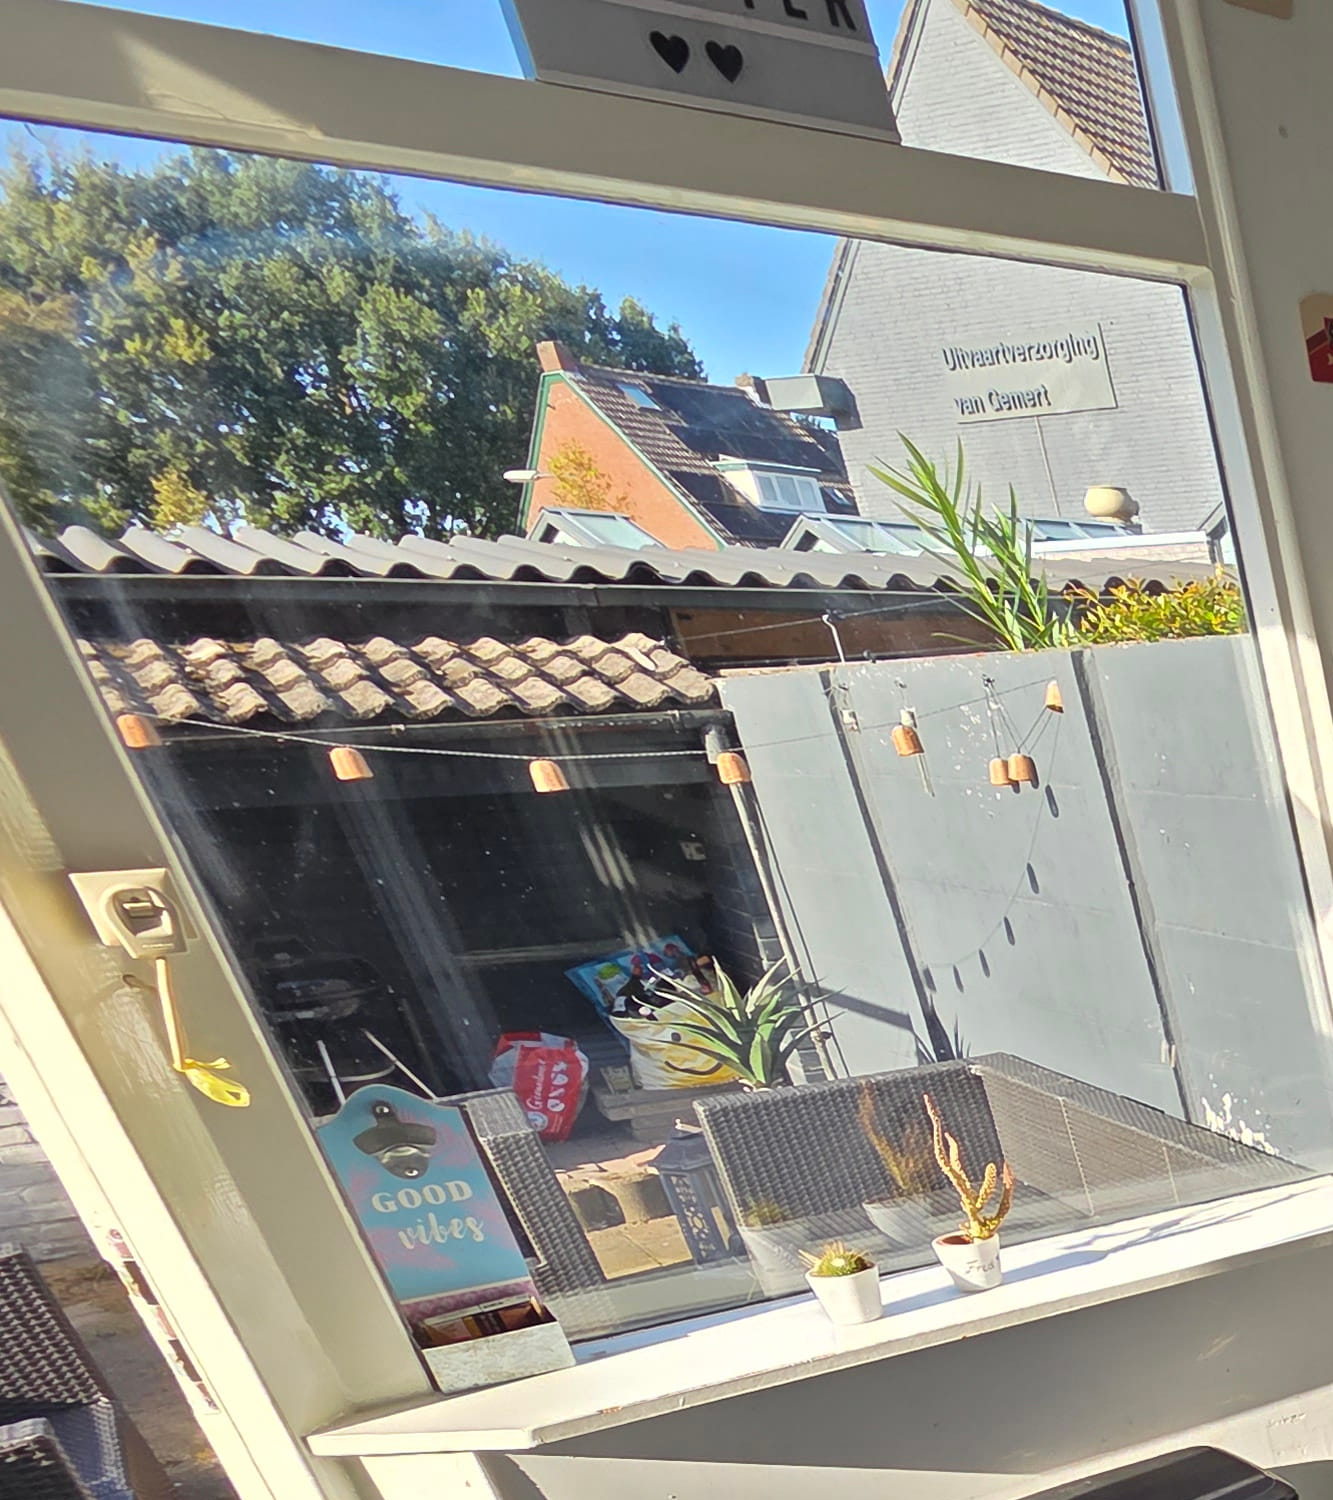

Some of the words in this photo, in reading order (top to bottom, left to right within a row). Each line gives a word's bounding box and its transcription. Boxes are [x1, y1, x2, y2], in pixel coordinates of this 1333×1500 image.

[943, 333, 1100, 371] Uitvaartverzorging
[955, 395, 986, 415] van
[988, 384, 1052, 412] Gemert
[371, 1180, 474, 1214] GOOD
[397, 1212, 486, 1251] vibes
